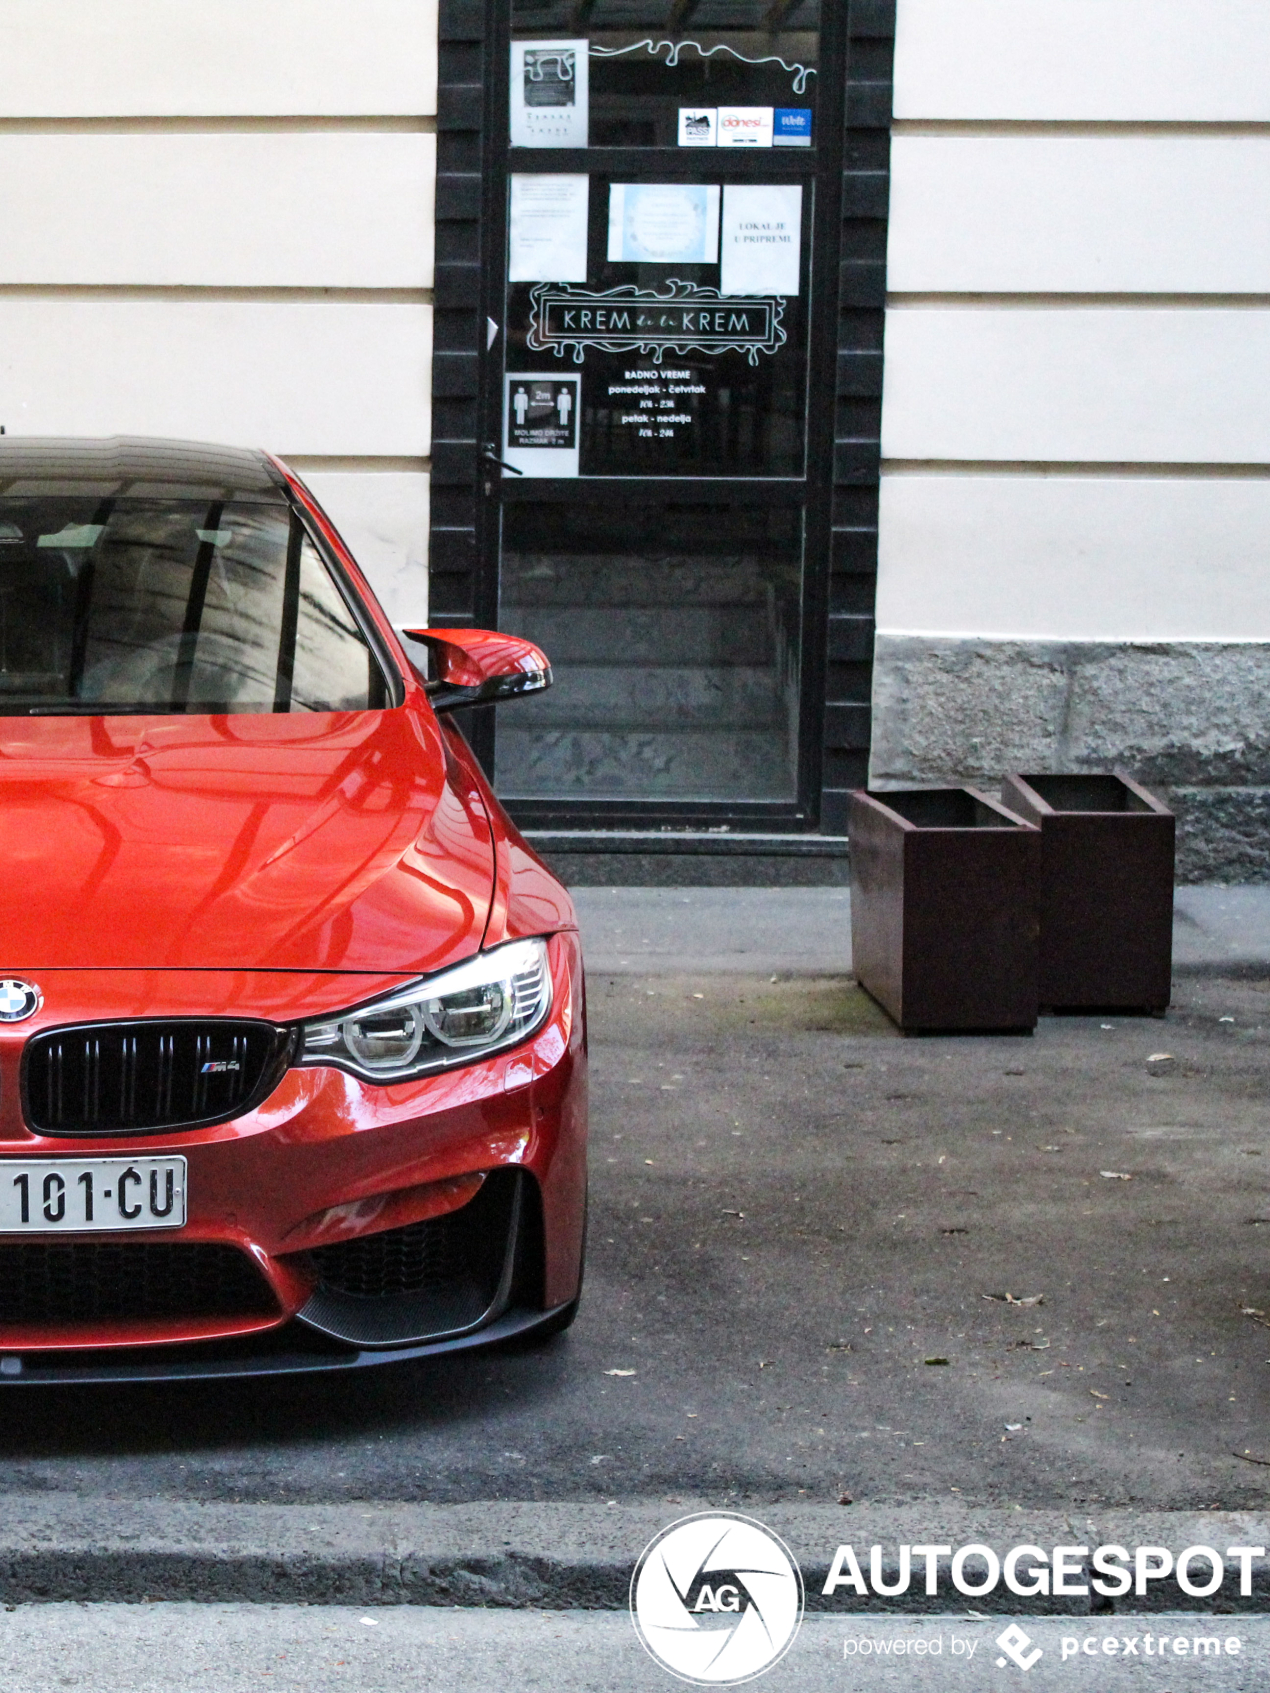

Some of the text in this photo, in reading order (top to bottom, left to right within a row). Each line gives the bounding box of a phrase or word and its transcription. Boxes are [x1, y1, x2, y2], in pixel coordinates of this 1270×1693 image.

[686, 127, 709, 135] PASS
[739, 222, 786, 231] LOKAL JE
[734, 235, 741, 243] U
[564, 310, 631, 330] KREM
[682, 312, 750, 331] KREM
[624, 371, 691, 379] RADNO VREME
[608, 385, 660, 395] ponedeljak
[668, 384, 707, 394] četvrtak
[535, 391, 550, 400] 2m
[622, 414, 649, 424] petak
[656, 414, 692, 424] nedelja
[201, 1061, 240, 1073] M4
